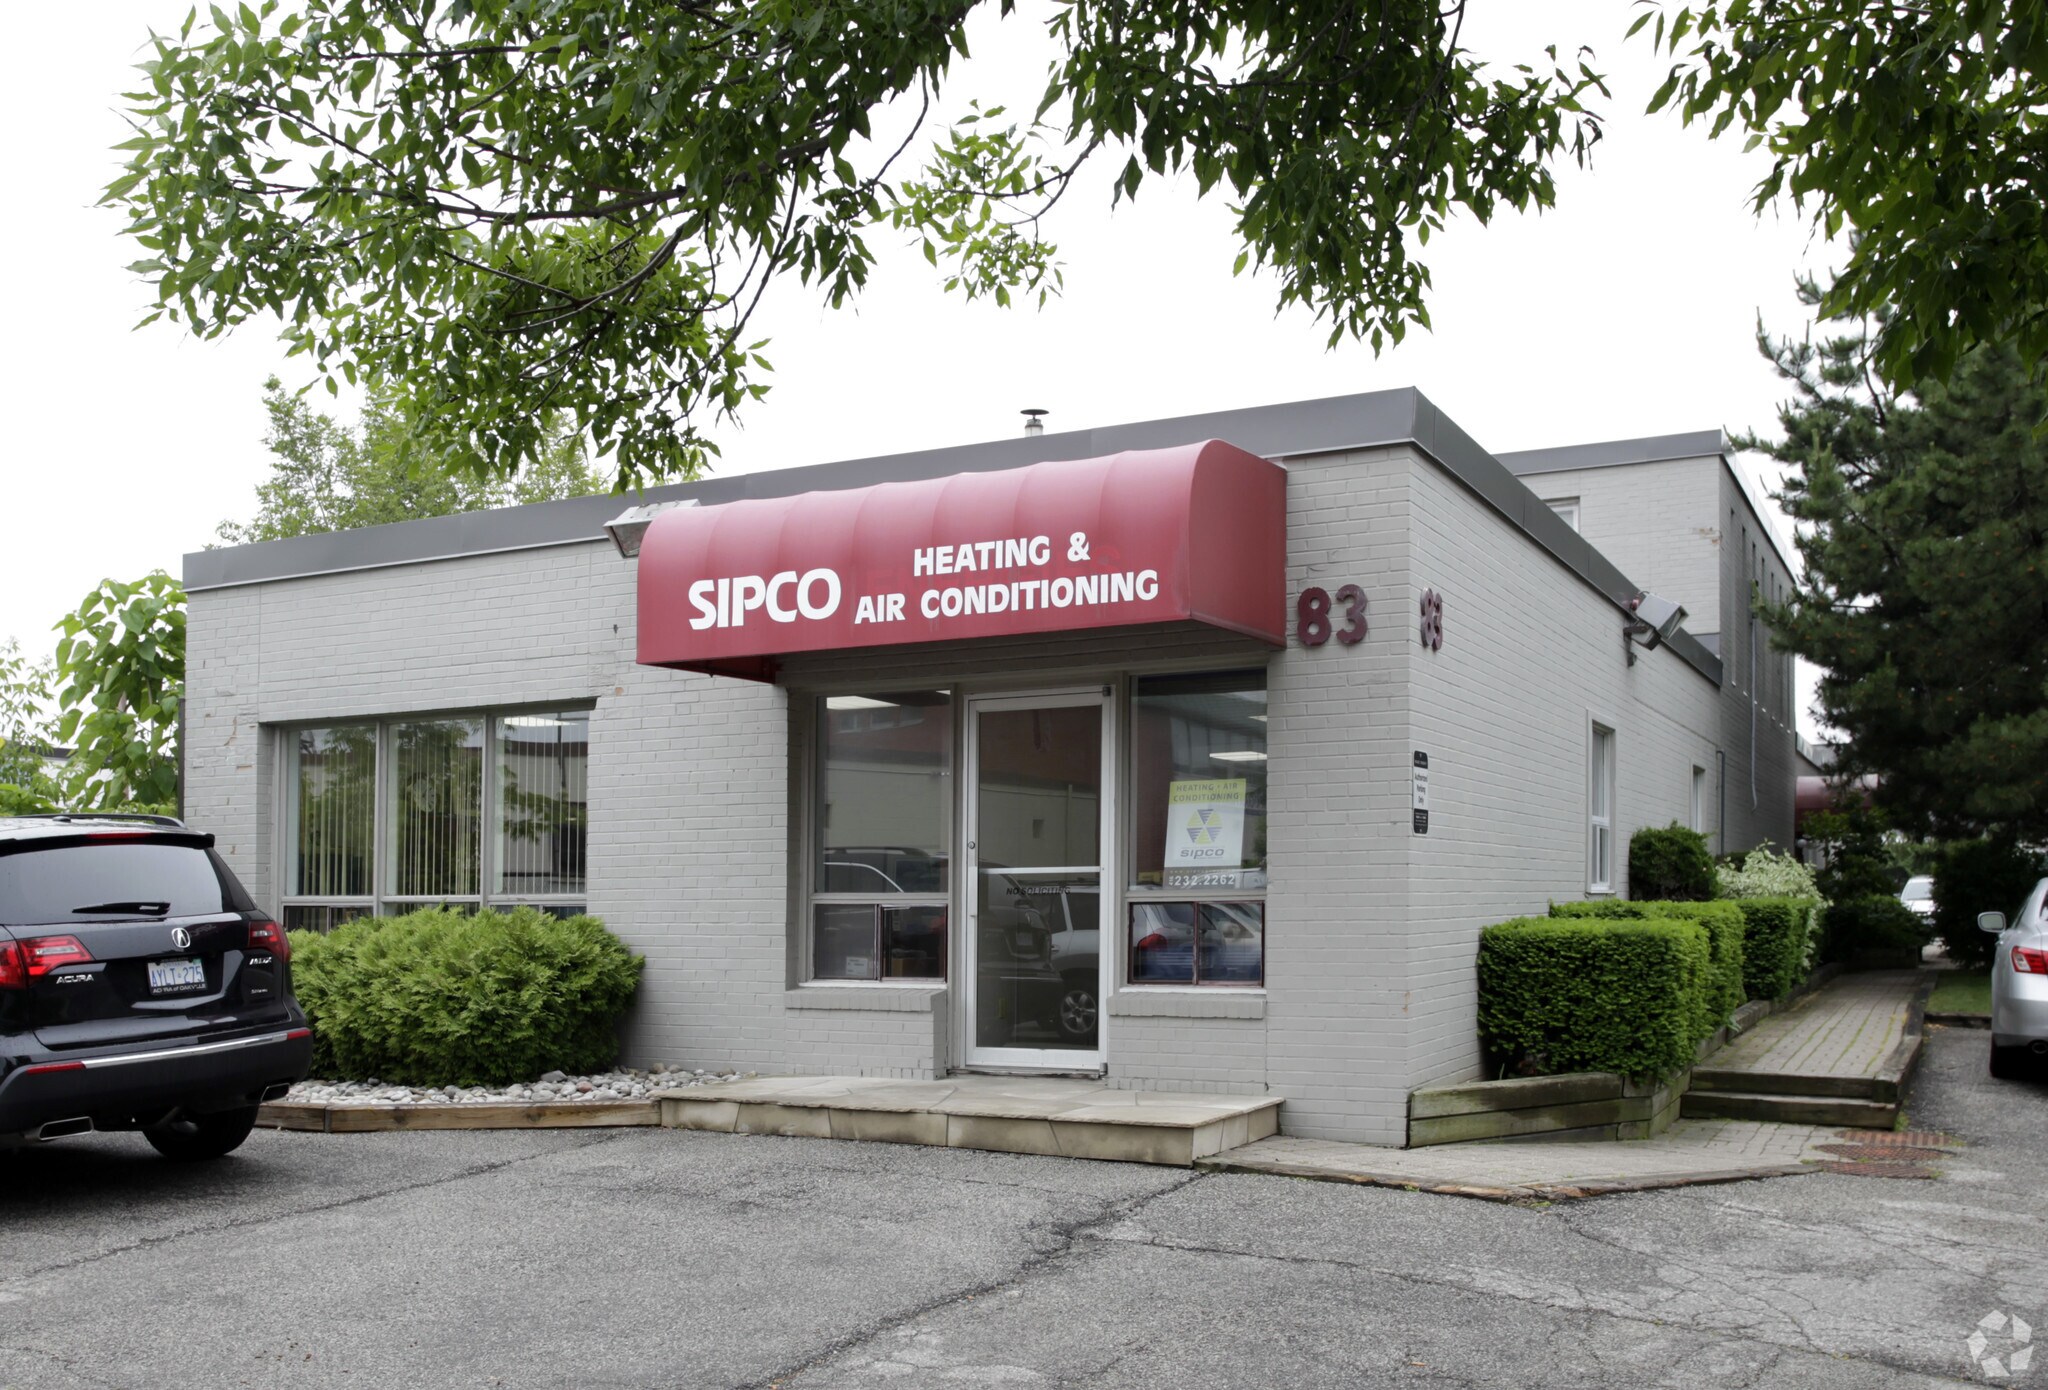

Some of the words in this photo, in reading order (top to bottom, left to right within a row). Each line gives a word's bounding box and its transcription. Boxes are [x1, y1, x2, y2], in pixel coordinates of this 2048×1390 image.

[913, 535, 1050, 577] HEATING
[1067, 531, 1091, 562] &
[687, 567, 842, 630] SIPCO
[854, 593, 907, 625] AIR
[920, 569, 1159, 620] CONDITIONING
[1297, 583, 1369, 647] 83
[1420, 587, 1443, 651] 83
[1173, 792, 1239, 802] CONDITIONING
[1176, 784, 1214, 792] HEATING
[1223, 782, 1238, 790] AIR
[1006, 887, 1019, 895] NO
[1021, 886, 1071, 896] SOLICITING
[1174, 874, 1235, 887] 232.2262
[56, 974, 94, 984] ACURA
